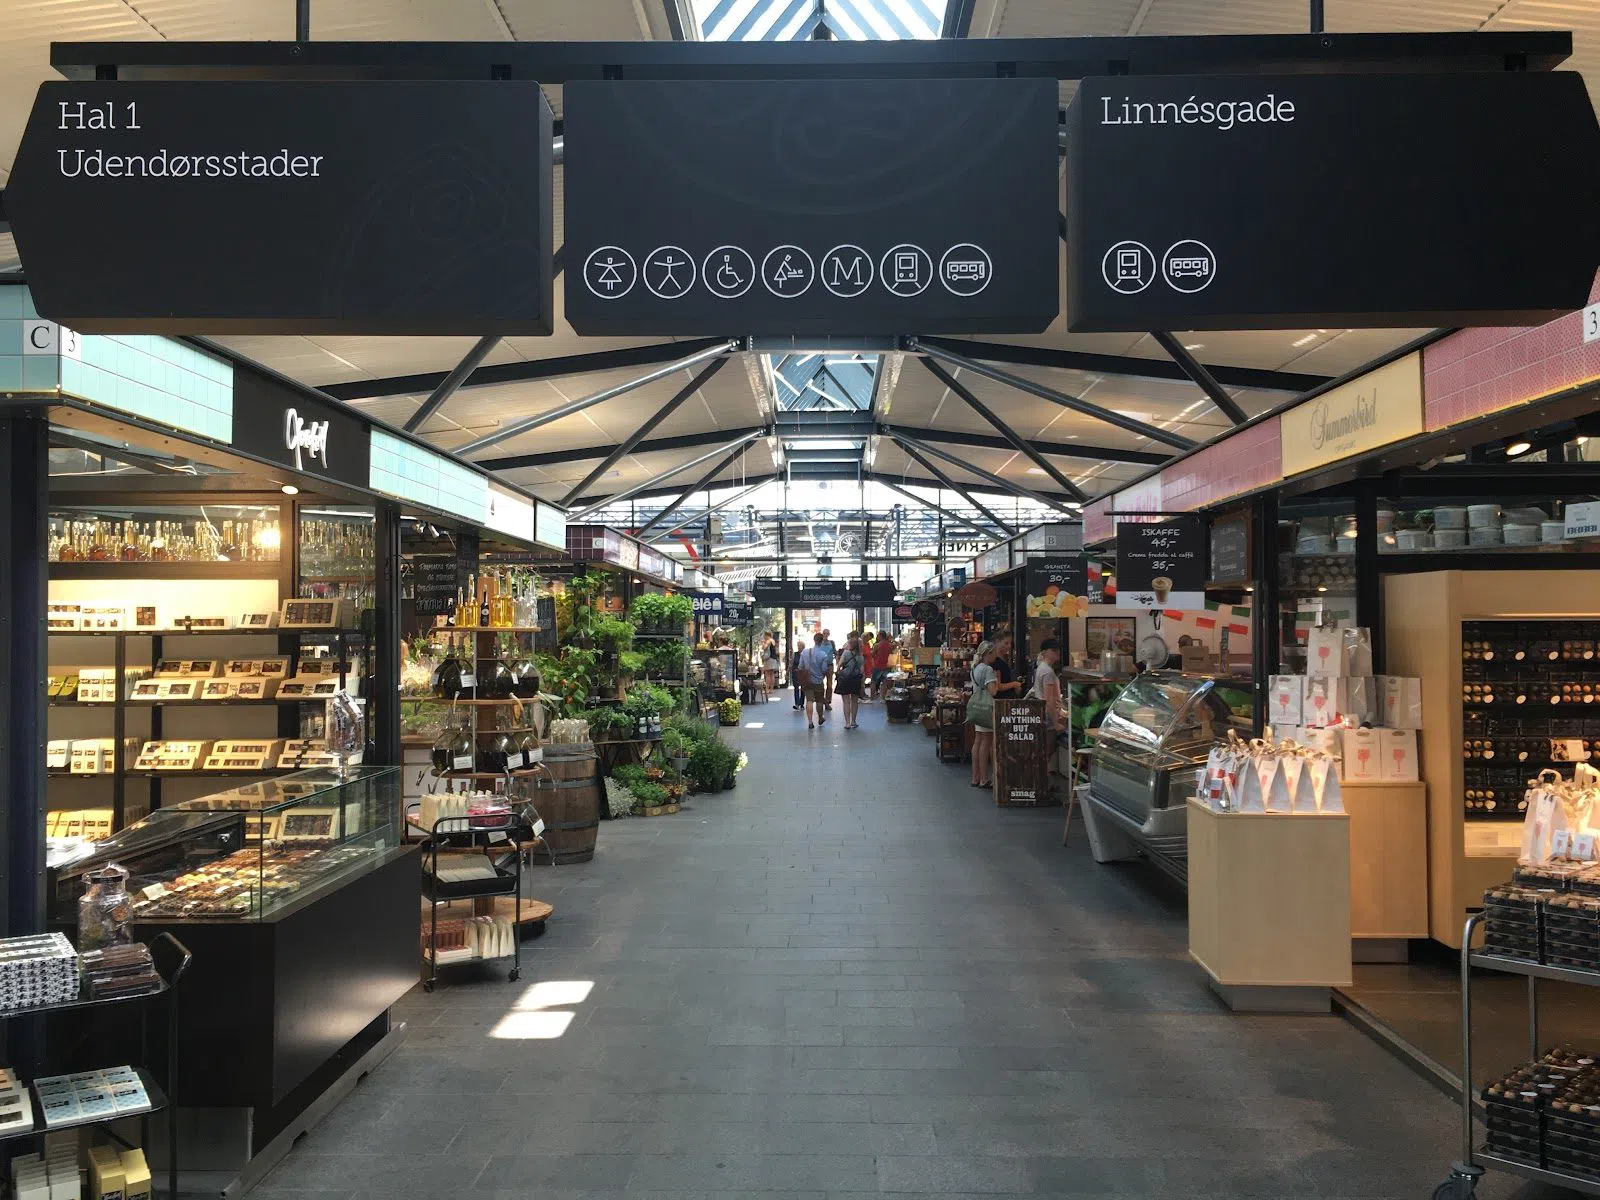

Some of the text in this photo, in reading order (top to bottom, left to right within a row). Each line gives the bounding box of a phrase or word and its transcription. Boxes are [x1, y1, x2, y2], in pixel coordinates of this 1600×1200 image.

[58, 101, 141, 129] Hal 1
[1101, 94, 1295, 130] Linnésgade
[58, 149, 323, 177] Udendørsstader
[830, 256, 865, 286] M
[1589, 311, 1598, 335] 3
[30, 325, 51, 349] C
[68, 329, 76, 353] 3
[1048, 536, 1055, 544] B
[1142, 528, 1180, 536] ISKAFFE
[1049, 574, 1070, 584] 30,-
[1000, 716, 1041, 724] ANYTHING
[1011, 708, 1030, 716] SKIP
[1008, 733, 1034, 741] SALAD
[1010, 790, 1035, 798] smag
